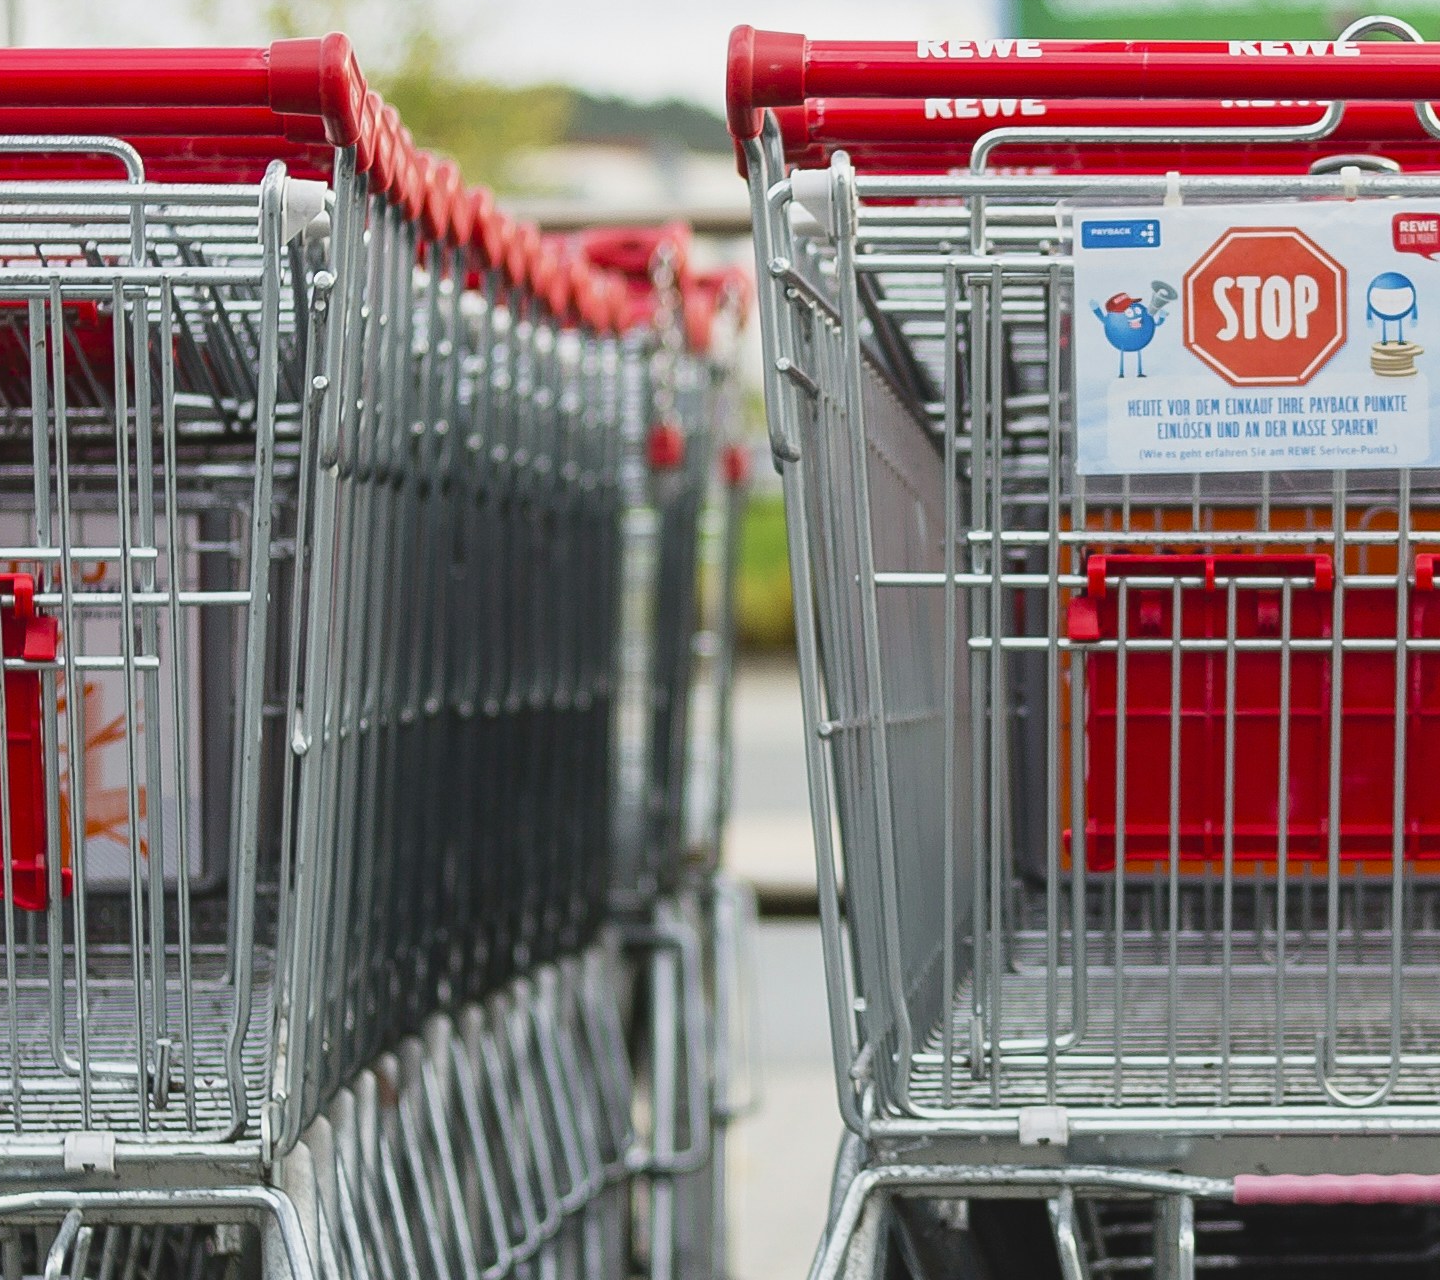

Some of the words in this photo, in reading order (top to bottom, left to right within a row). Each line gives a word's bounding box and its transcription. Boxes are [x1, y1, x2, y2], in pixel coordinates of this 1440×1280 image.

[924, 98, 1047, 120] REWE
[1091, 227, 1131, 236] PAYBACK
[1399, 220, 1438, 232] REWE
[1212, 274, 1320, 341] STOP
[1127, 399, 1163, 417] HEUTE
[1167, 399, 1190, 416] VOR
[1196, 398, 1220, 415] DEM
[1225, 397, 1273, 415] EINKAUF
[1278, 397, 1305, 414] IHRE
[1309, 396, 1360, 414] PAYBACK
[1364, 395, 1407, 412] PUNKTE
[1157, 418, 1212, 439] EINLÖSEN
[1217, 421, 1240, 438] UND
[1244, 420, 1260, 438] AN
[1265, 420, 1287, 437] DER
[1292, 419, 1327, 437] KASSE
[1331, 418, 1378, 436] SPAREN!
[1139, 449, 1162, 460] (Wie
[1166, 450, 1177, 458] es
[1180, 449, 1202, 460] geht
[1205, 448, 1248, 458] erfahren
[1250, 447, 1266, 457] Sie
[1269, 448, 1285, 456] am
[1288, 446, 1316, 457] REWE
